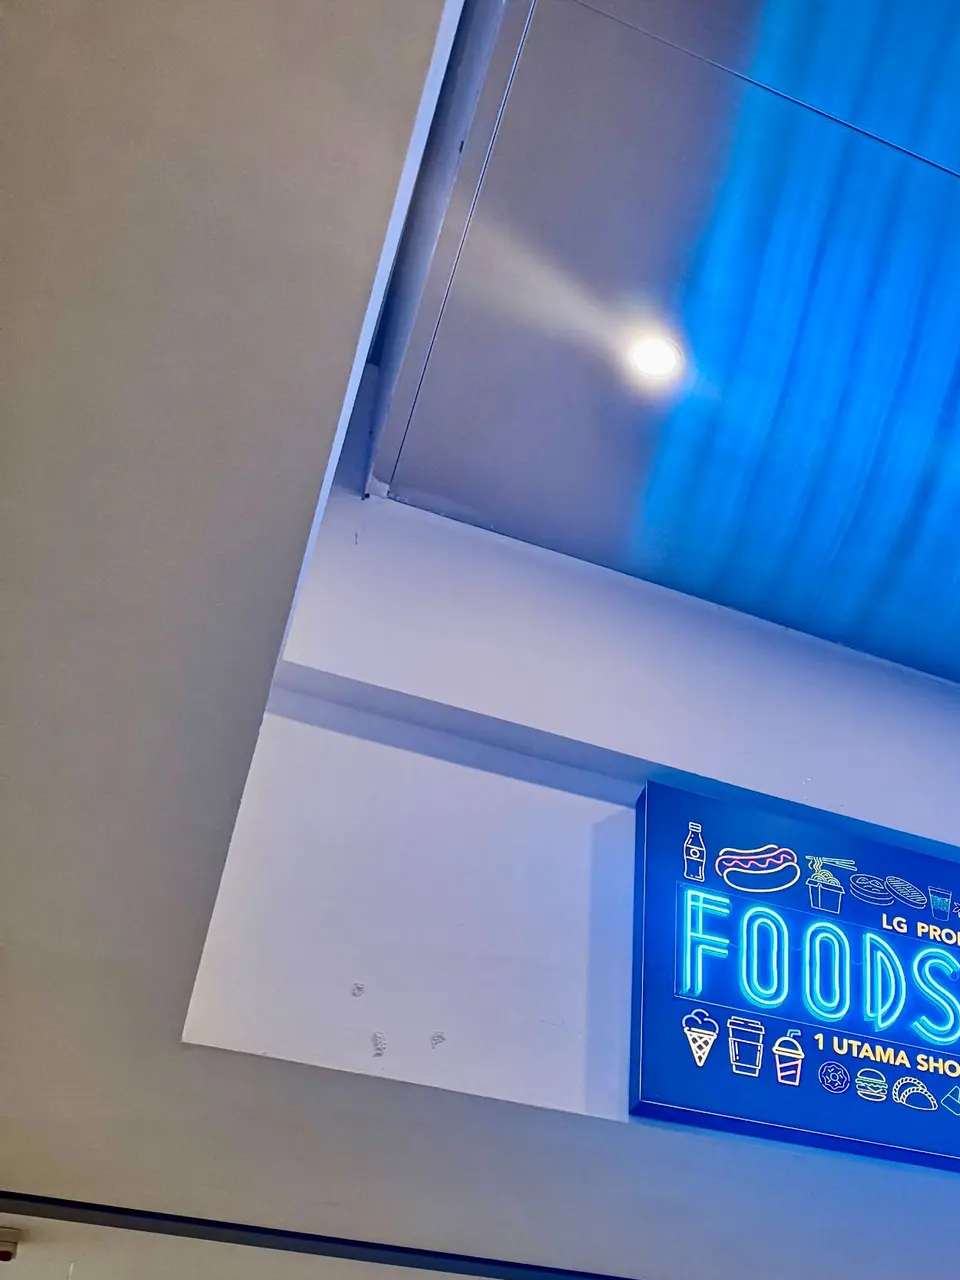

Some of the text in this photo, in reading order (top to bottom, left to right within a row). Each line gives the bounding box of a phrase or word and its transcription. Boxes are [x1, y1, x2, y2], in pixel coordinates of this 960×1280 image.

[882, 913, 908, 933] LG
[814, 1033, 824, 1050] 1
[833, 1035, 911, 1069] UTAMA
